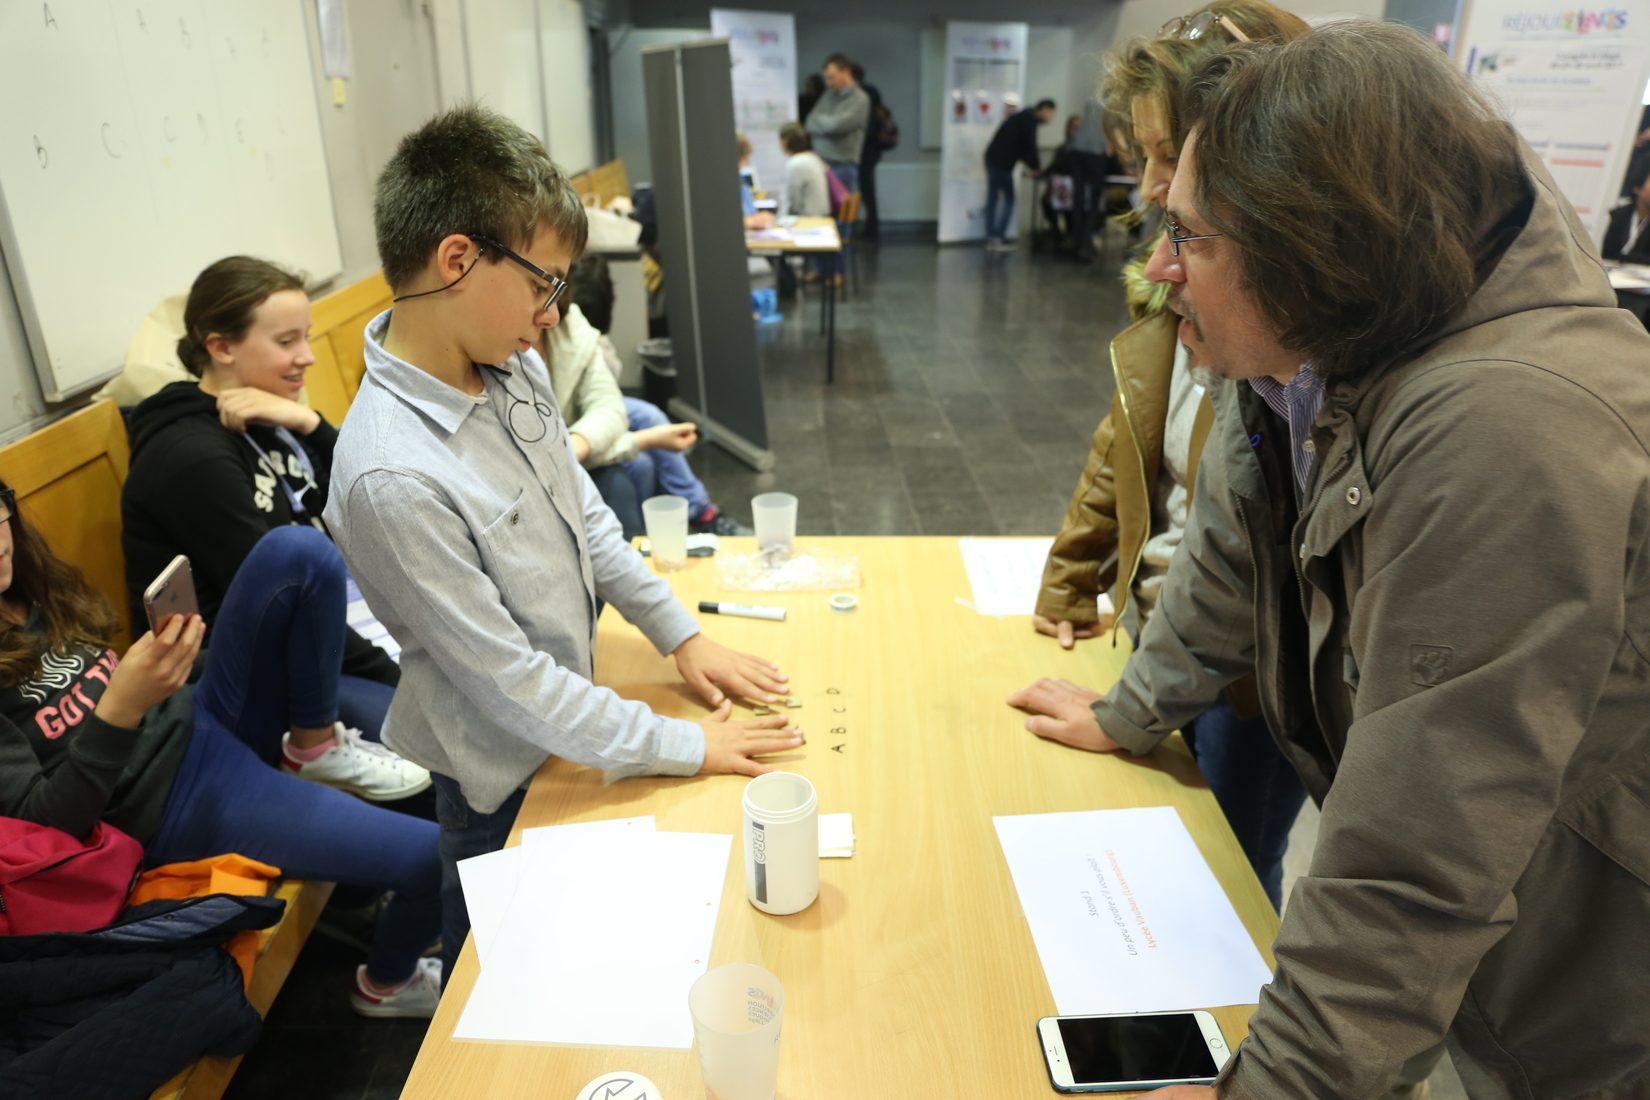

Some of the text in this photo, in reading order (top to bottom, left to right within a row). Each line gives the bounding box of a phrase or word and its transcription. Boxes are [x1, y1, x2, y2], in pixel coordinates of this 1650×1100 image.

[43, 1, 60, 31] A
[100, 120, 122, 160] C
[826, 687, 840, 695] D
[34, 681, 97, 740] GOT
[830, 726, 847, 735] B
[830, 743, 847, 755] A
[1083, 896, 1099, 916] Stand
[1127, 897, 1146, 926] Vauban
[1120, 928, 1135, 943] peu
[1141, 926, 1157, 949] Lycée
[1126, 944, 1138, 956] Un
